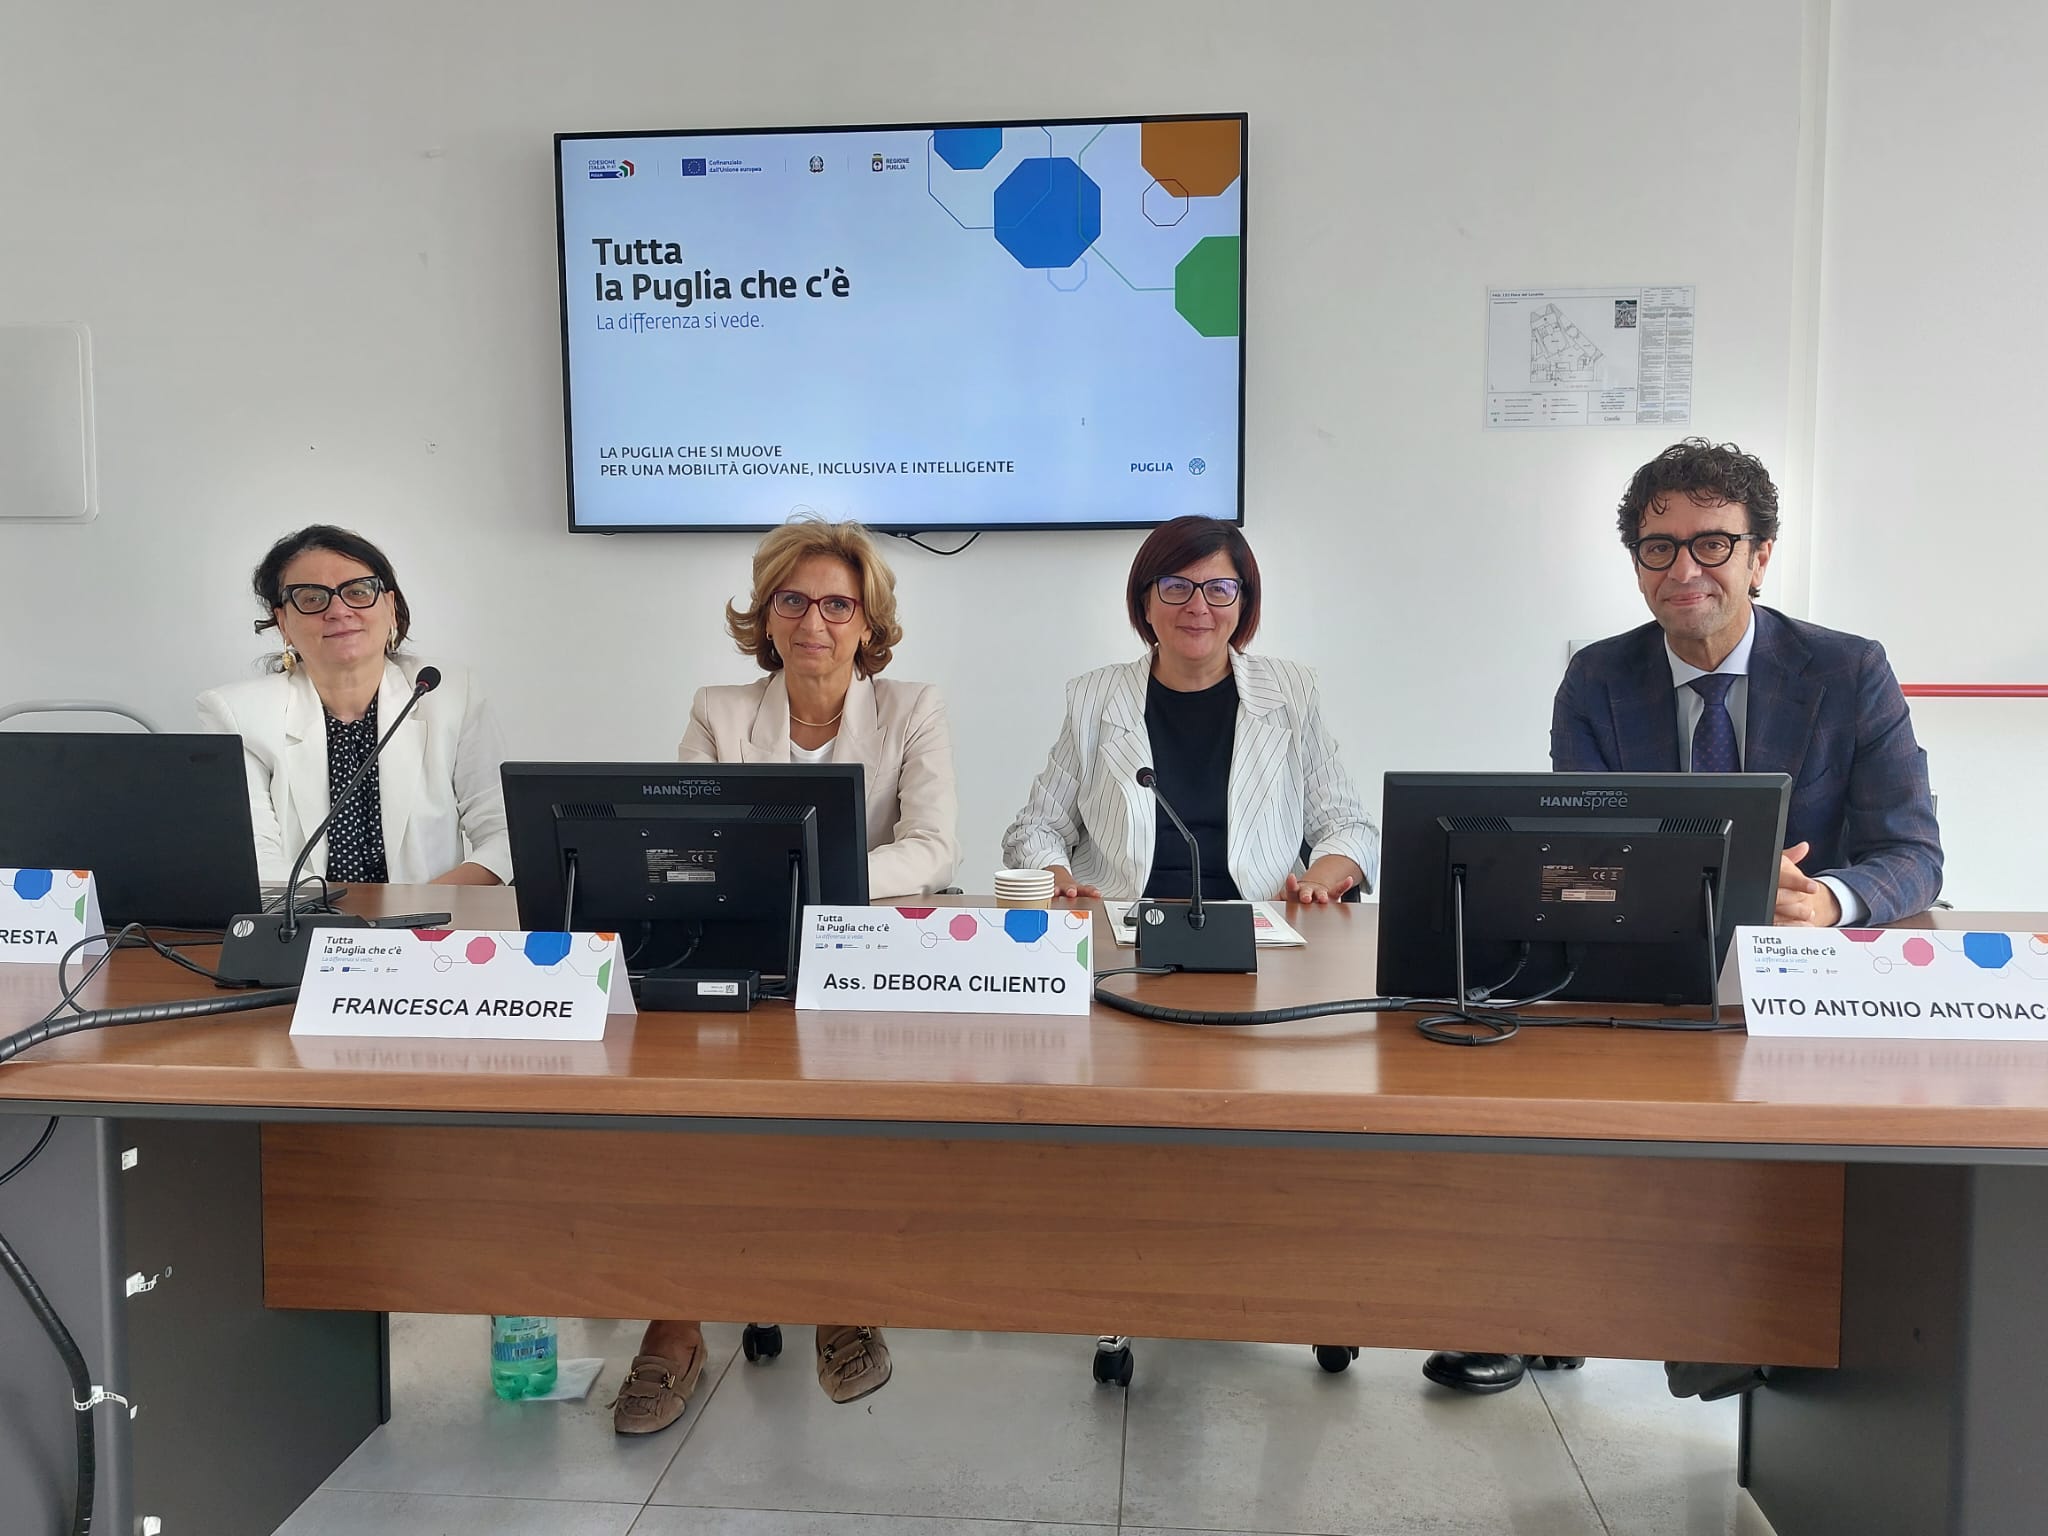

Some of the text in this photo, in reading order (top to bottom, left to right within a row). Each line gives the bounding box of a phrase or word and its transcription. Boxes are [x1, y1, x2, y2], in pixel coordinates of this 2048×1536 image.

[592, 238, 683, 265] Tutta
[595, 265, 850, 308] la Puglia che c'è
[597, 311, 765, 333] La differenza si vede.
[600, 445, 782, 459] LA PUGLIA CHE SI MUOVE
[601, 461, 1015, 477] PER UNA MOBILITÀ GIOVANE, INCLUSIVA E INTELLIGENTE
[1130, 462, 1174, 472] PUGLIA
[1540, 796, 1628, 811] HANNspree
[817, 914, 843, 922] Tutta
[816, 923, 825, 931] la
[827, 923, 856, 933] Puglia
[858, 924, 875, 932] che
[0, 929, 58, 944] RESTA
[327, 936, 354, 944] Tutta
[1752, 936, 1782, 944] Tutta
[324, 945, 333, 954] la
[336, 945, 366, 956] Puglia
[368, 946, 386, 954] che
[1753, 946, 1763, 954] la
[1766, 946, 1798, 956] Puglia
[1800, 947, 1819, 955] che
[823, 973, 1066, 994] Ass. DEBORA CILIENTO
[332, 997, 573, 1018] FRANCESCA ARBORE
[1751, 998, 2048, 1020] VITO ANTONIO ANTONAC
